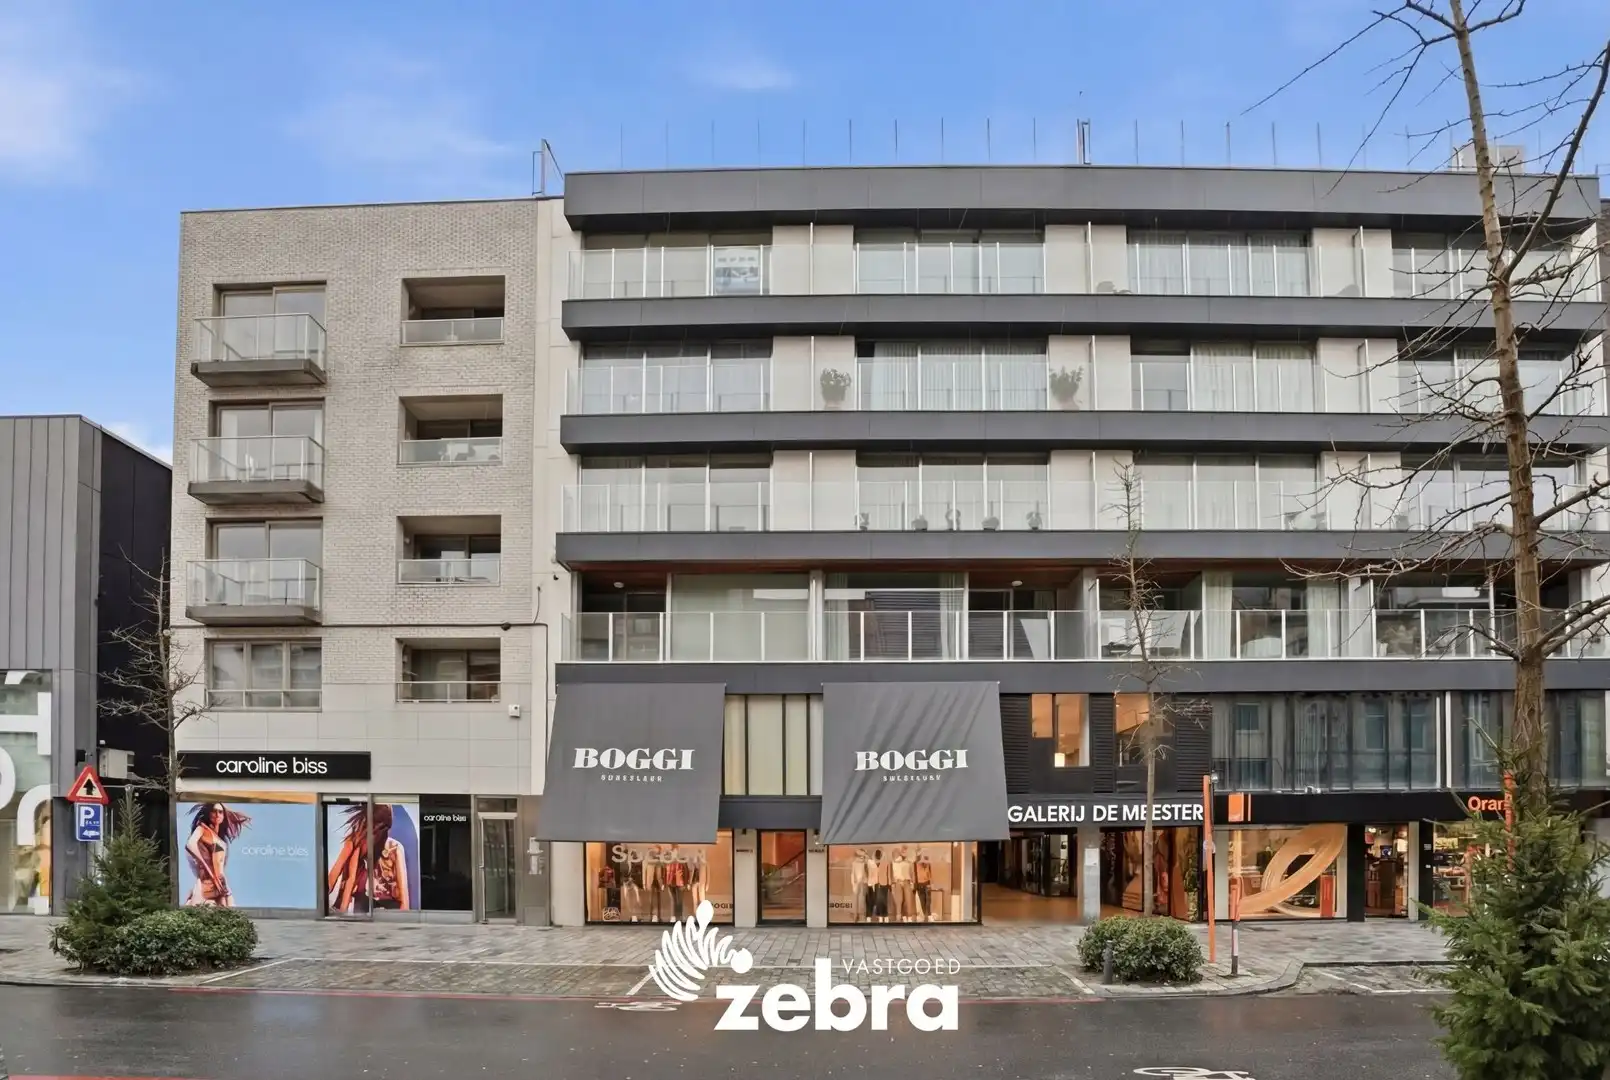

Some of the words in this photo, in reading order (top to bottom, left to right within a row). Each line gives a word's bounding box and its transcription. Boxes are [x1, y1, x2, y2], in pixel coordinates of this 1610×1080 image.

[216, 757, 287, 774] caroline
[293, 757, 328, 774] biss
[573, 748, 695, 770] BOGGI
[854, 749, 969, 771] BOGGI
[80, 806, 95, 827] P
[1007, 805, 1086, 823] GALERIJ
[1093, 805, 1119, 822] DE
[1123, 804, 1204, 821] MEESTER
